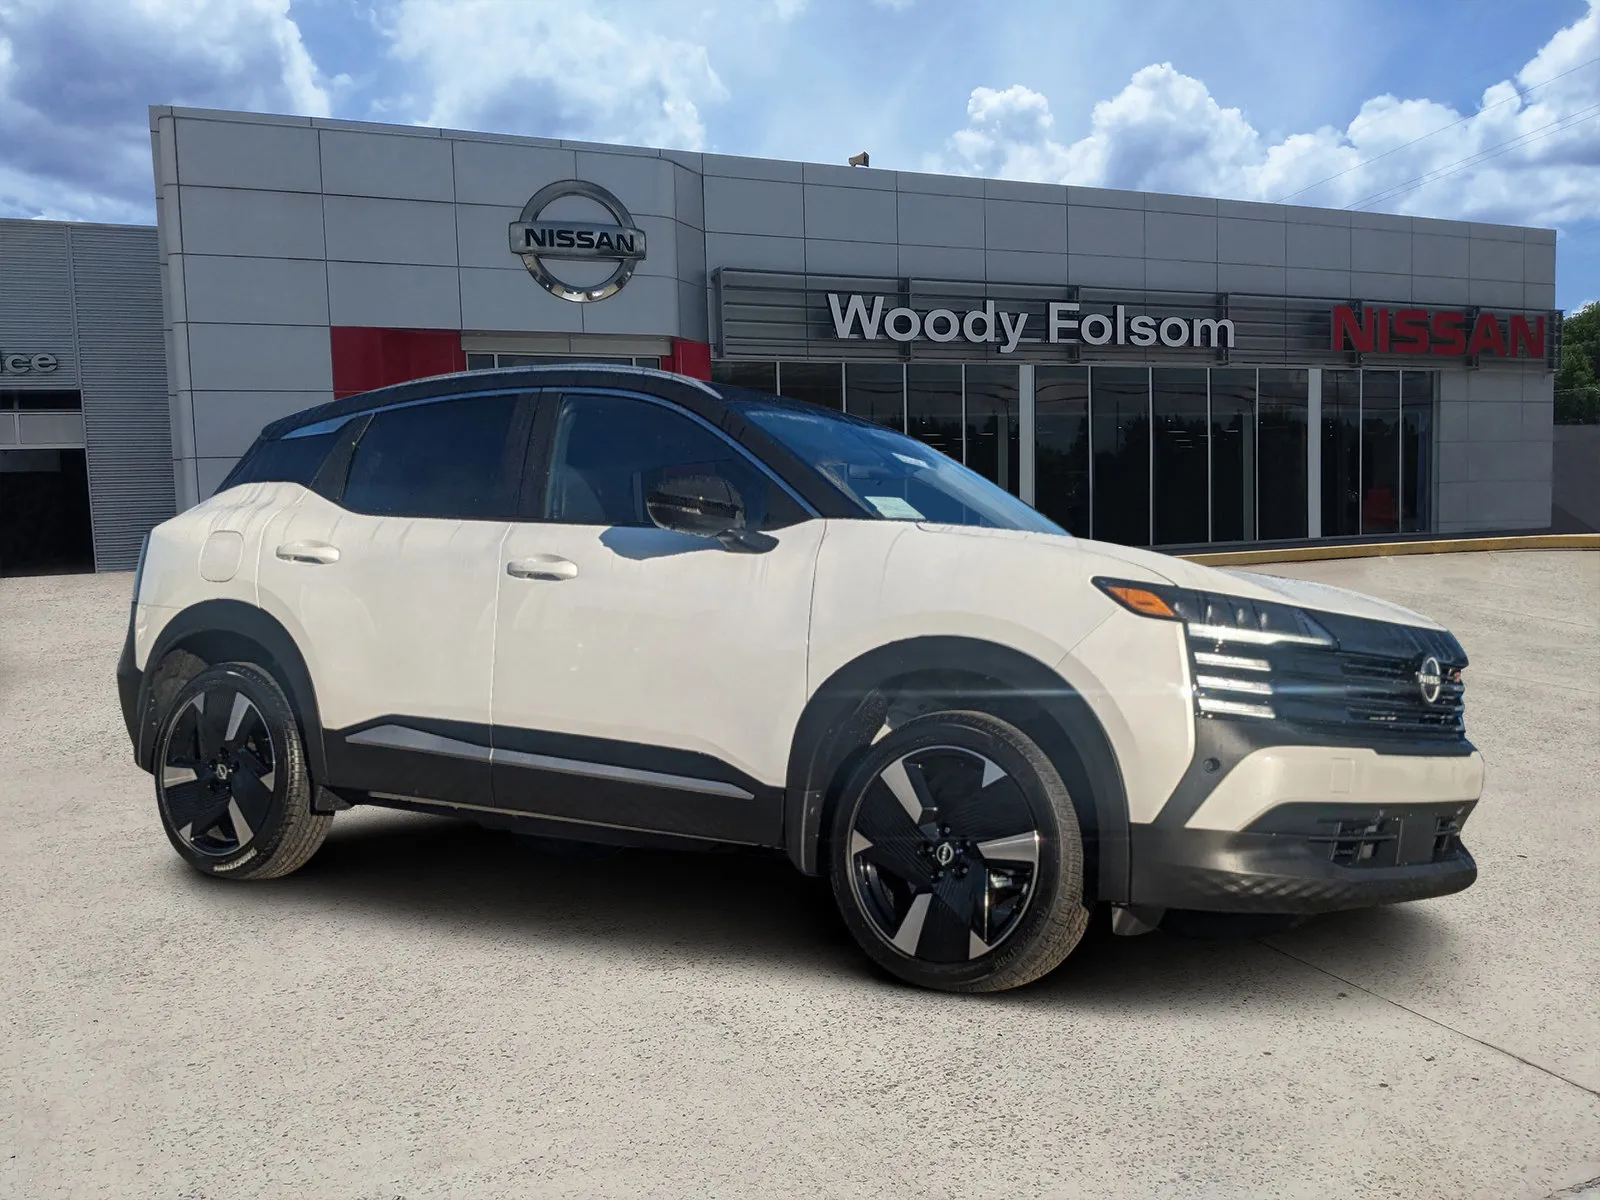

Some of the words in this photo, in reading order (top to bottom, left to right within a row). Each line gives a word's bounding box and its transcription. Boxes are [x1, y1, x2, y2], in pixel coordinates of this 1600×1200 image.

[524, 228, 635, 252] NISSAN
[827, 293, 1029, 353] Woody
[1047, 301, 1236, 348] Folsom
[1332, 305, 1546, 358] NISSAN
